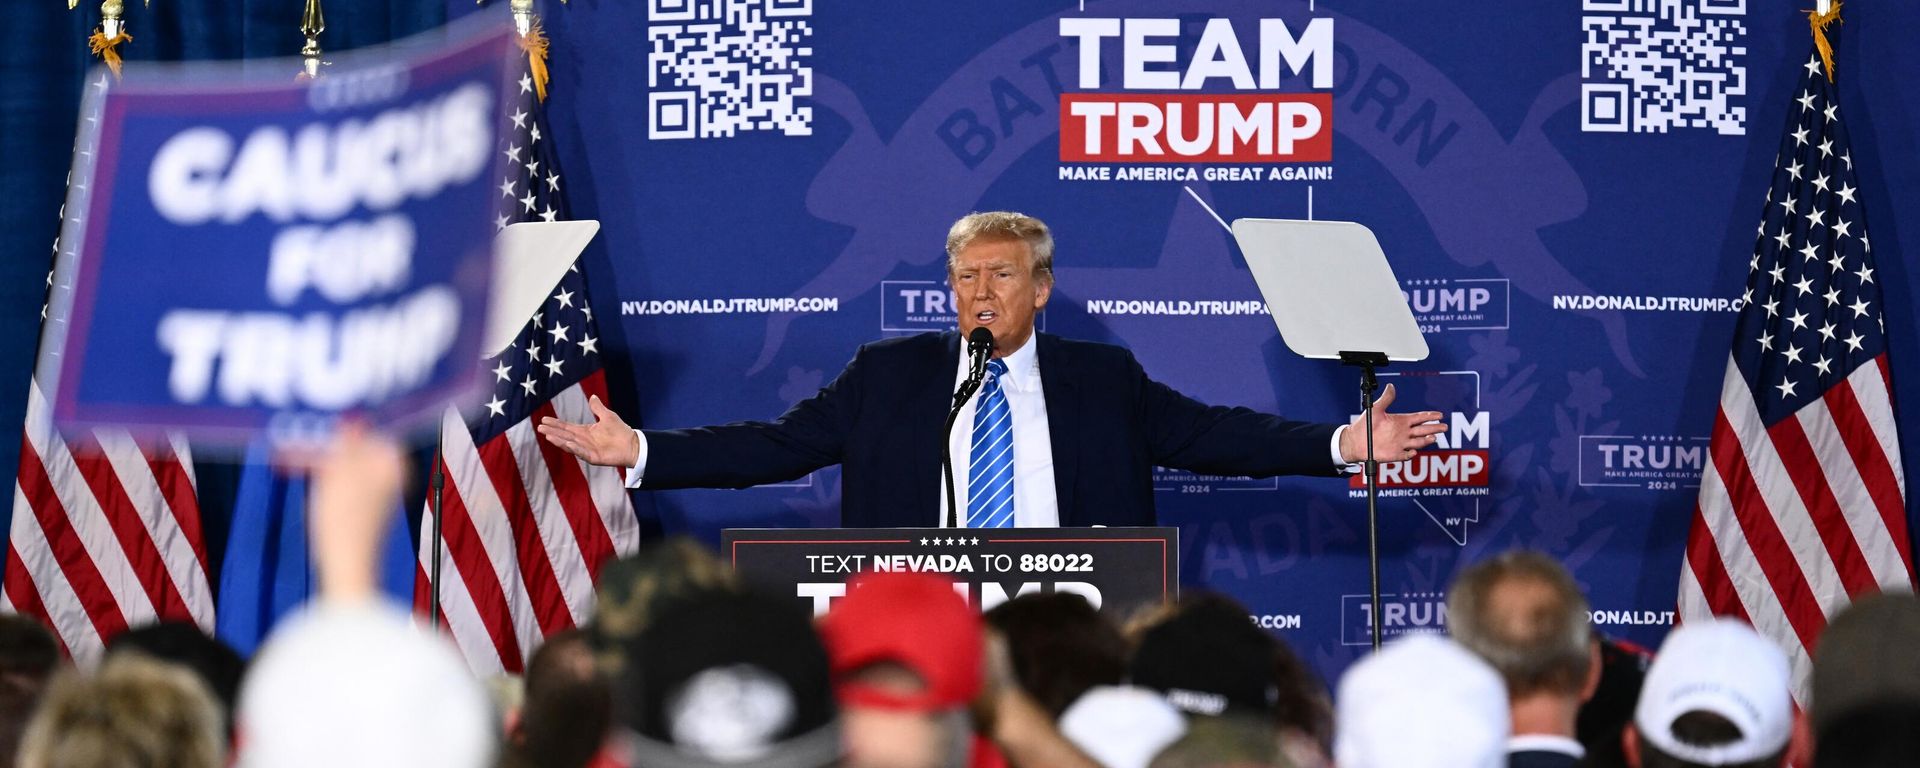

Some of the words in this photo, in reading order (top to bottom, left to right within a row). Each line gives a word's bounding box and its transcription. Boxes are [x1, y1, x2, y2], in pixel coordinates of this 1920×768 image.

[1059, 17, 1335, 90] TEAM
[1071, 102, 1322, 156] TRUMP
[1059, 166, 1111, 181] MAKE
[1115, 166, 1199, 182] AMERICA
[1204, 166, 1264, 182] GREAT
[1268, 166, 1333, 181] AGAIN!
[621, 297, 838, 315] NV.DONALDJTRUMP.COM
[1087, 300, 1271, 315] NV.DONALDJTRUMP.
[1402, 288, 1490, 312] UMP
[1553, 295, 1743, 312] NV.DONALDJTRUMP.C
[1419, 325, 1441, 333] 024
[1598, 445, 1710, 469] TRUM
[1181, 485, 1210, 493] 2024
[1378, 489, 1421, 498] AMERICA
[1423, 488, 1453, 497] GREAT
[1456, 487, 1489, 496] AGAIN!
[1647, 481, 1677, 490] 2024
[1446, 517, 1461, 526] NV
[806, 555, 866, 573] TEXT
[873, 555, 974, 573] NEVADA
[980, 554, 1012, 572] TO
[1019, 553, 1094, 572] 88022
